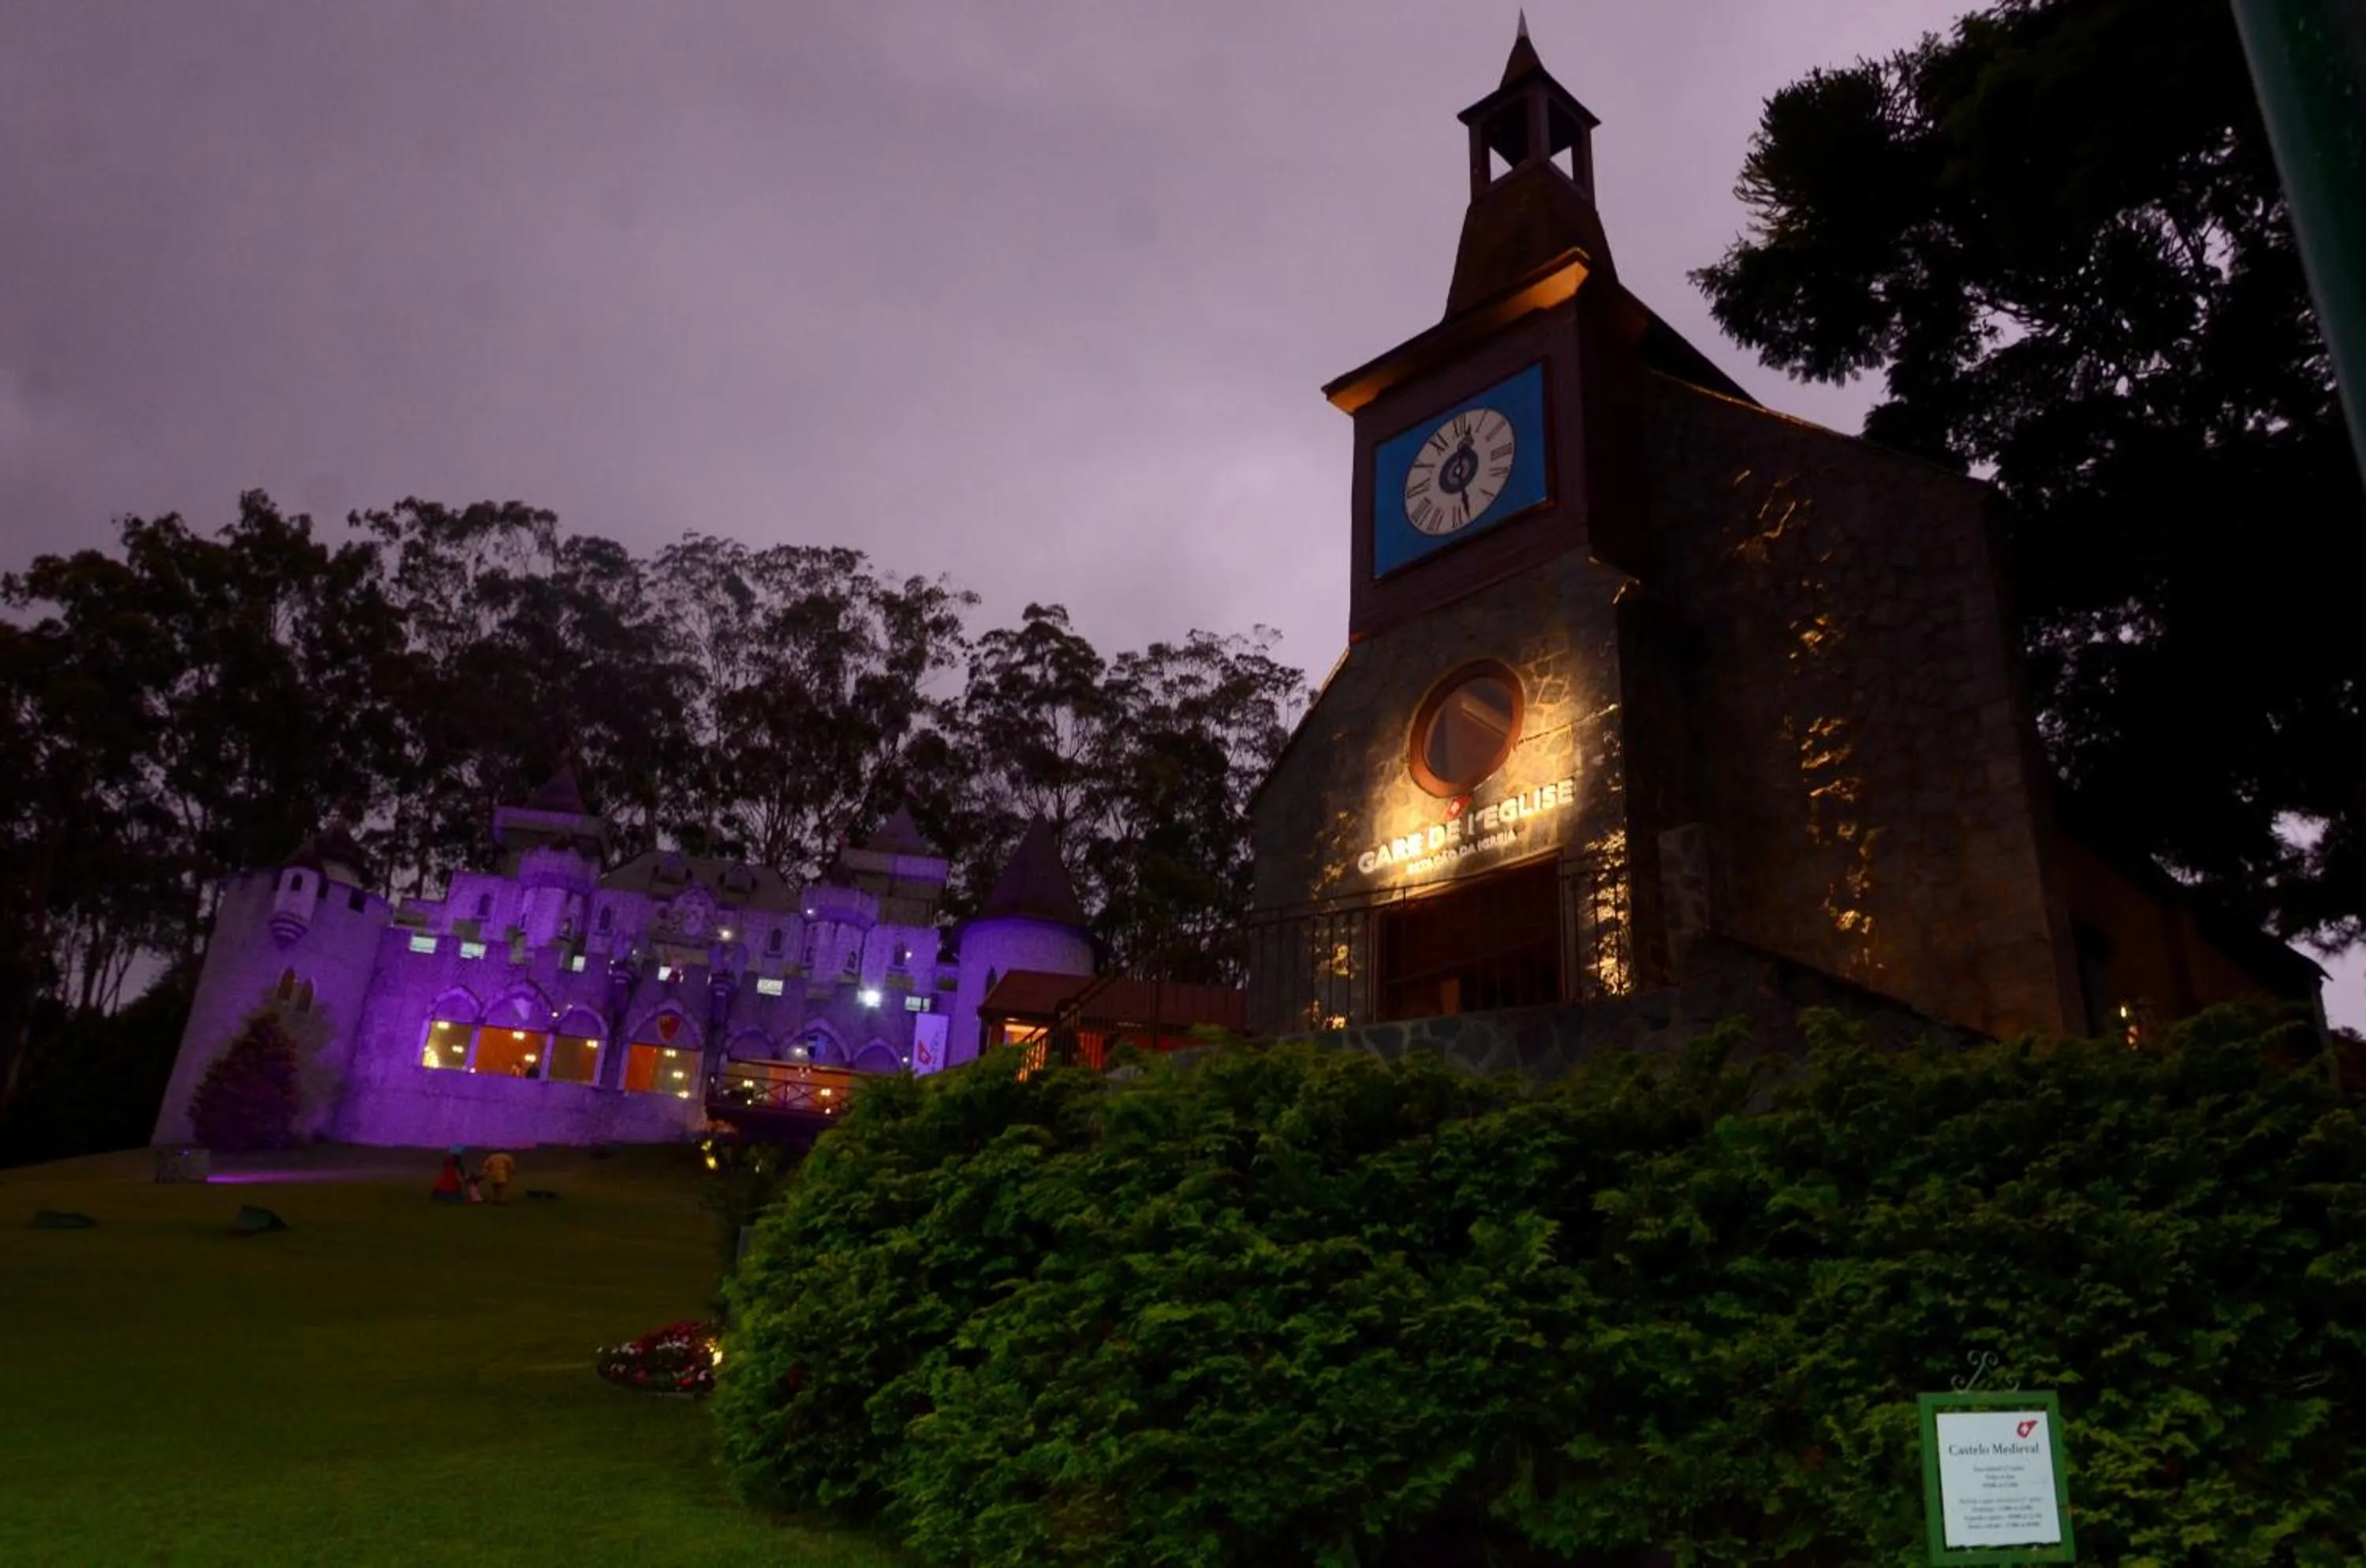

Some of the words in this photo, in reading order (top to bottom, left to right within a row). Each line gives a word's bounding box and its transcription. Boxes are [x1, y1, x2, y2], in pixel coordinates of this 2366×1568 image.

[1357, 831, 1423, 874] GARE
[1428, 818, 1461, 850] DE
[1948, 1443, 1990, 1455] Castelo
[1991, 1442, 2040, 1454] Medieval
